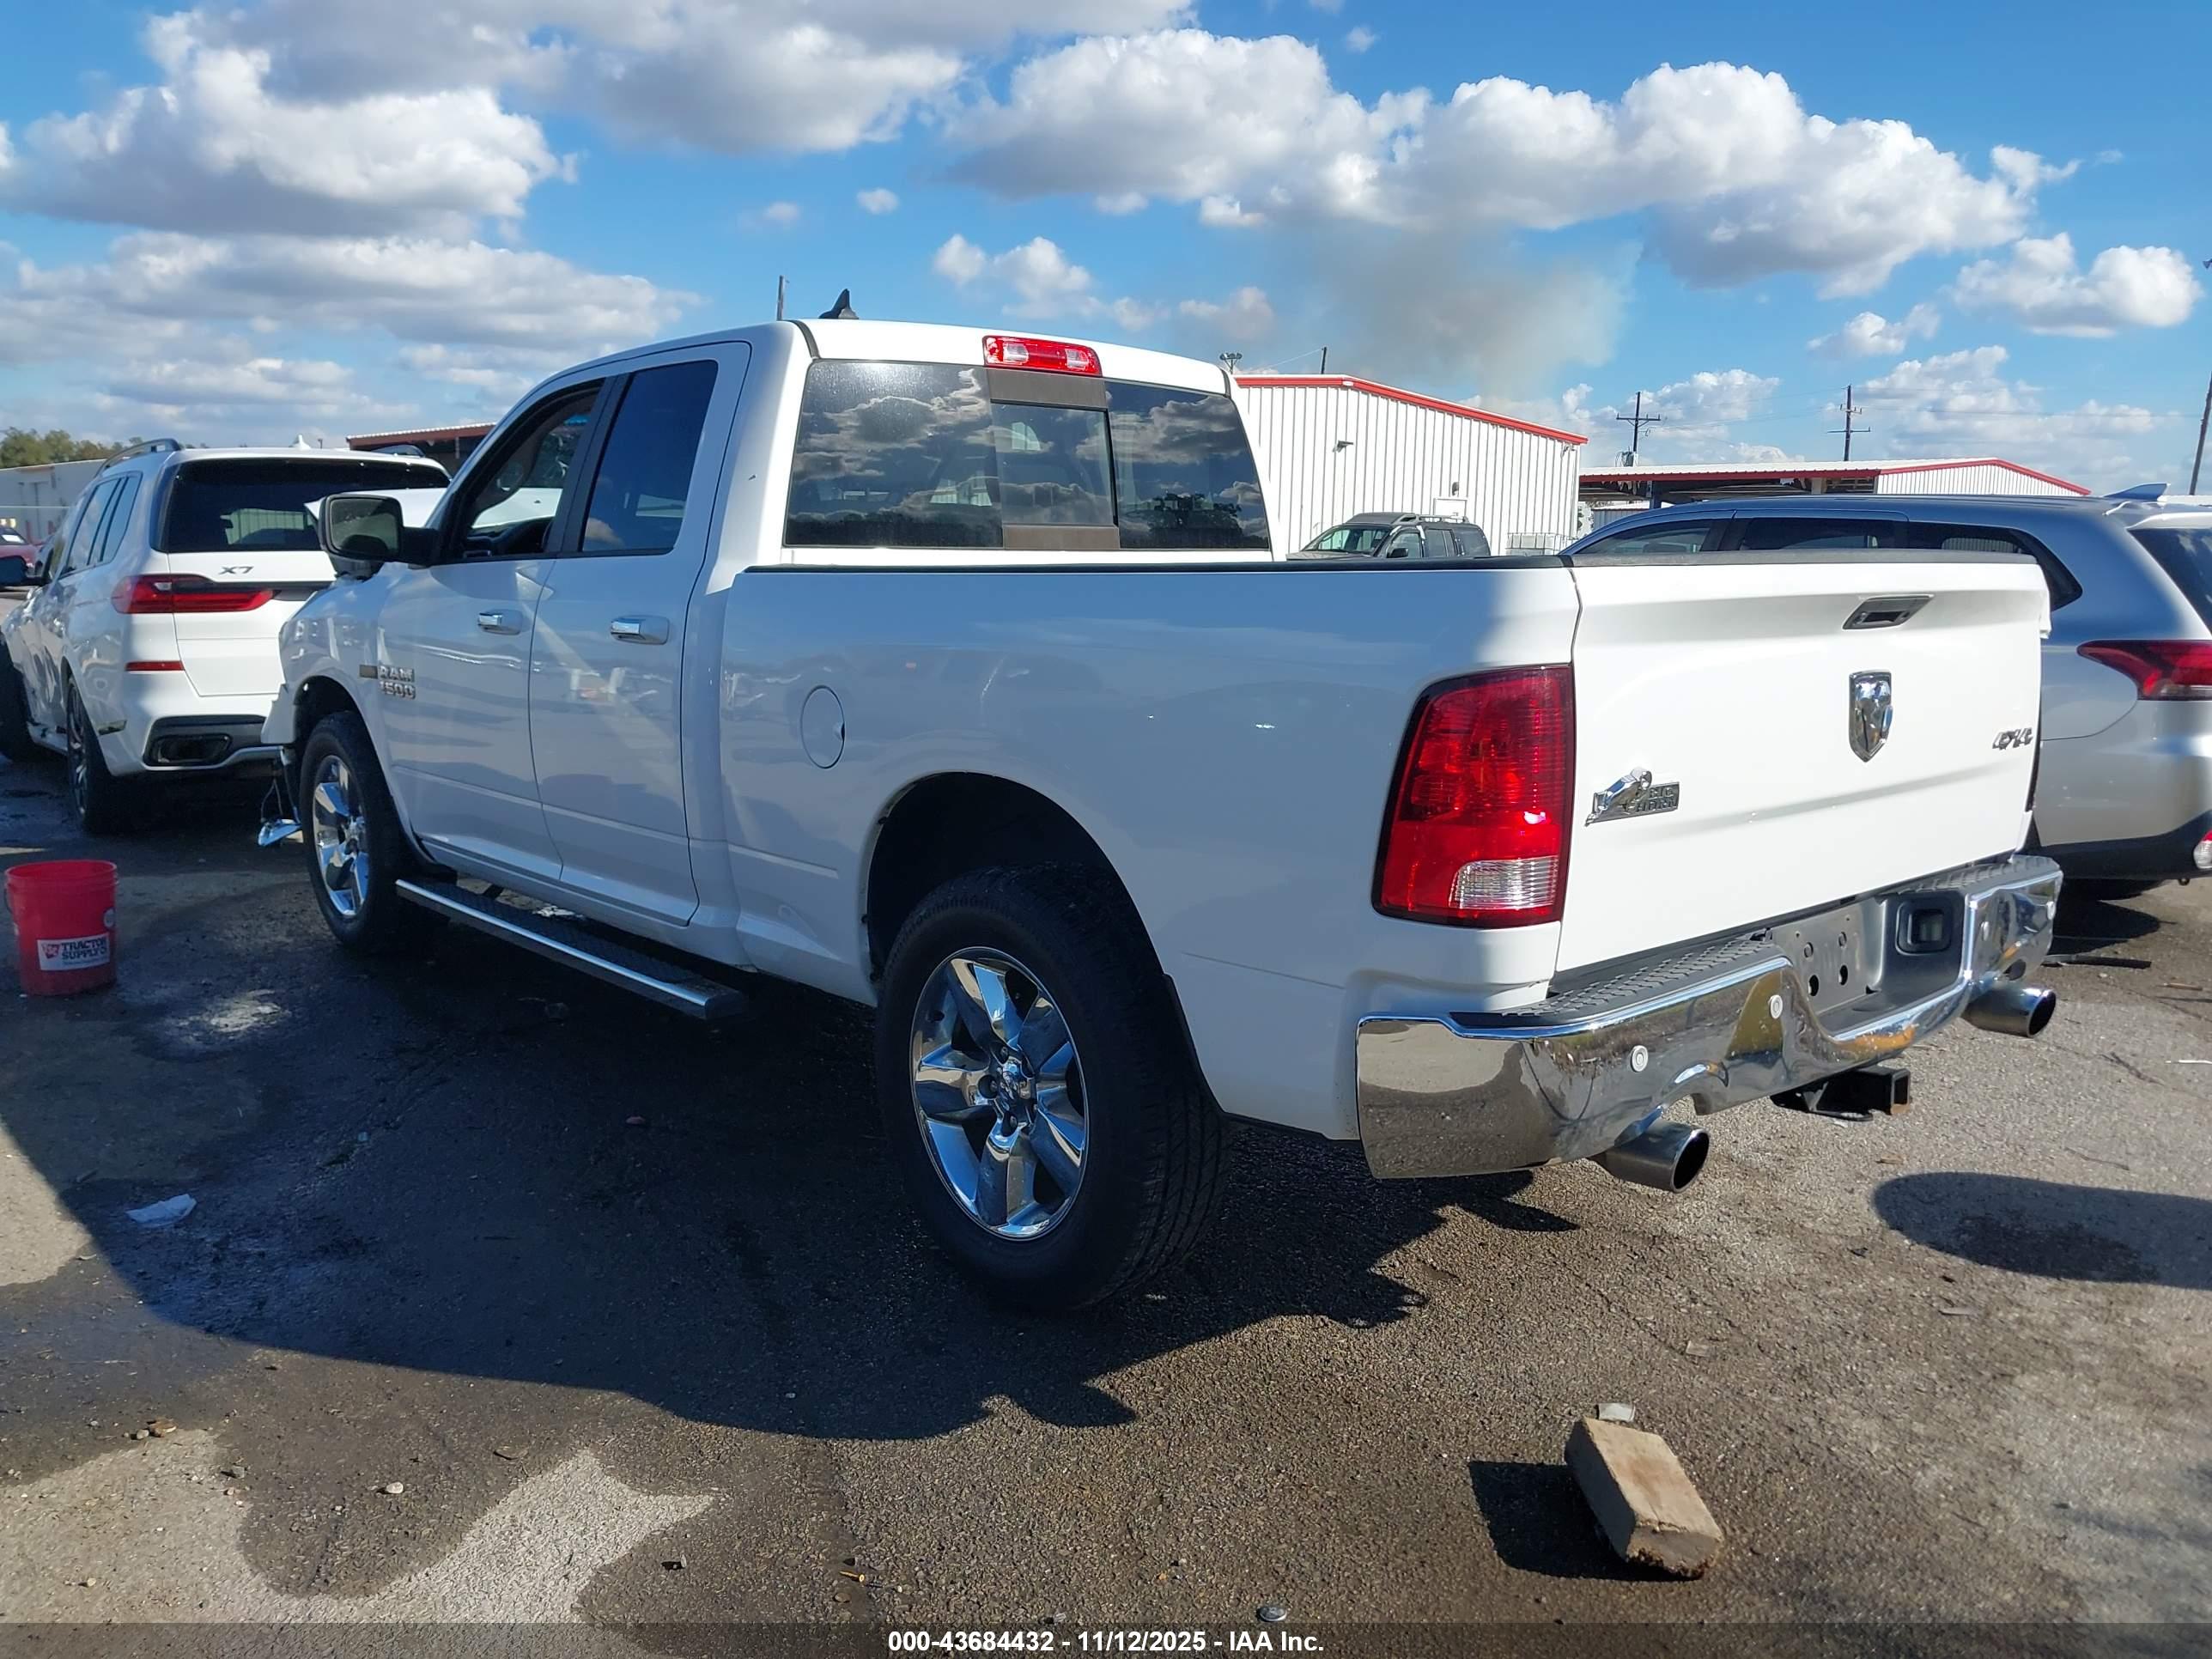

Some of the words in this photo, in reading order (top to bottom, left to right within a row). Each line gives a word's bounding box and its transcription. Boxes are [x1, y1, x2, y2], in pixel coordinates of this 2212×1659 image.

[217, 565, 255, 575] X7
[379, 665, 415, 683] RAM
[379, 680, 416, 700] 1500
